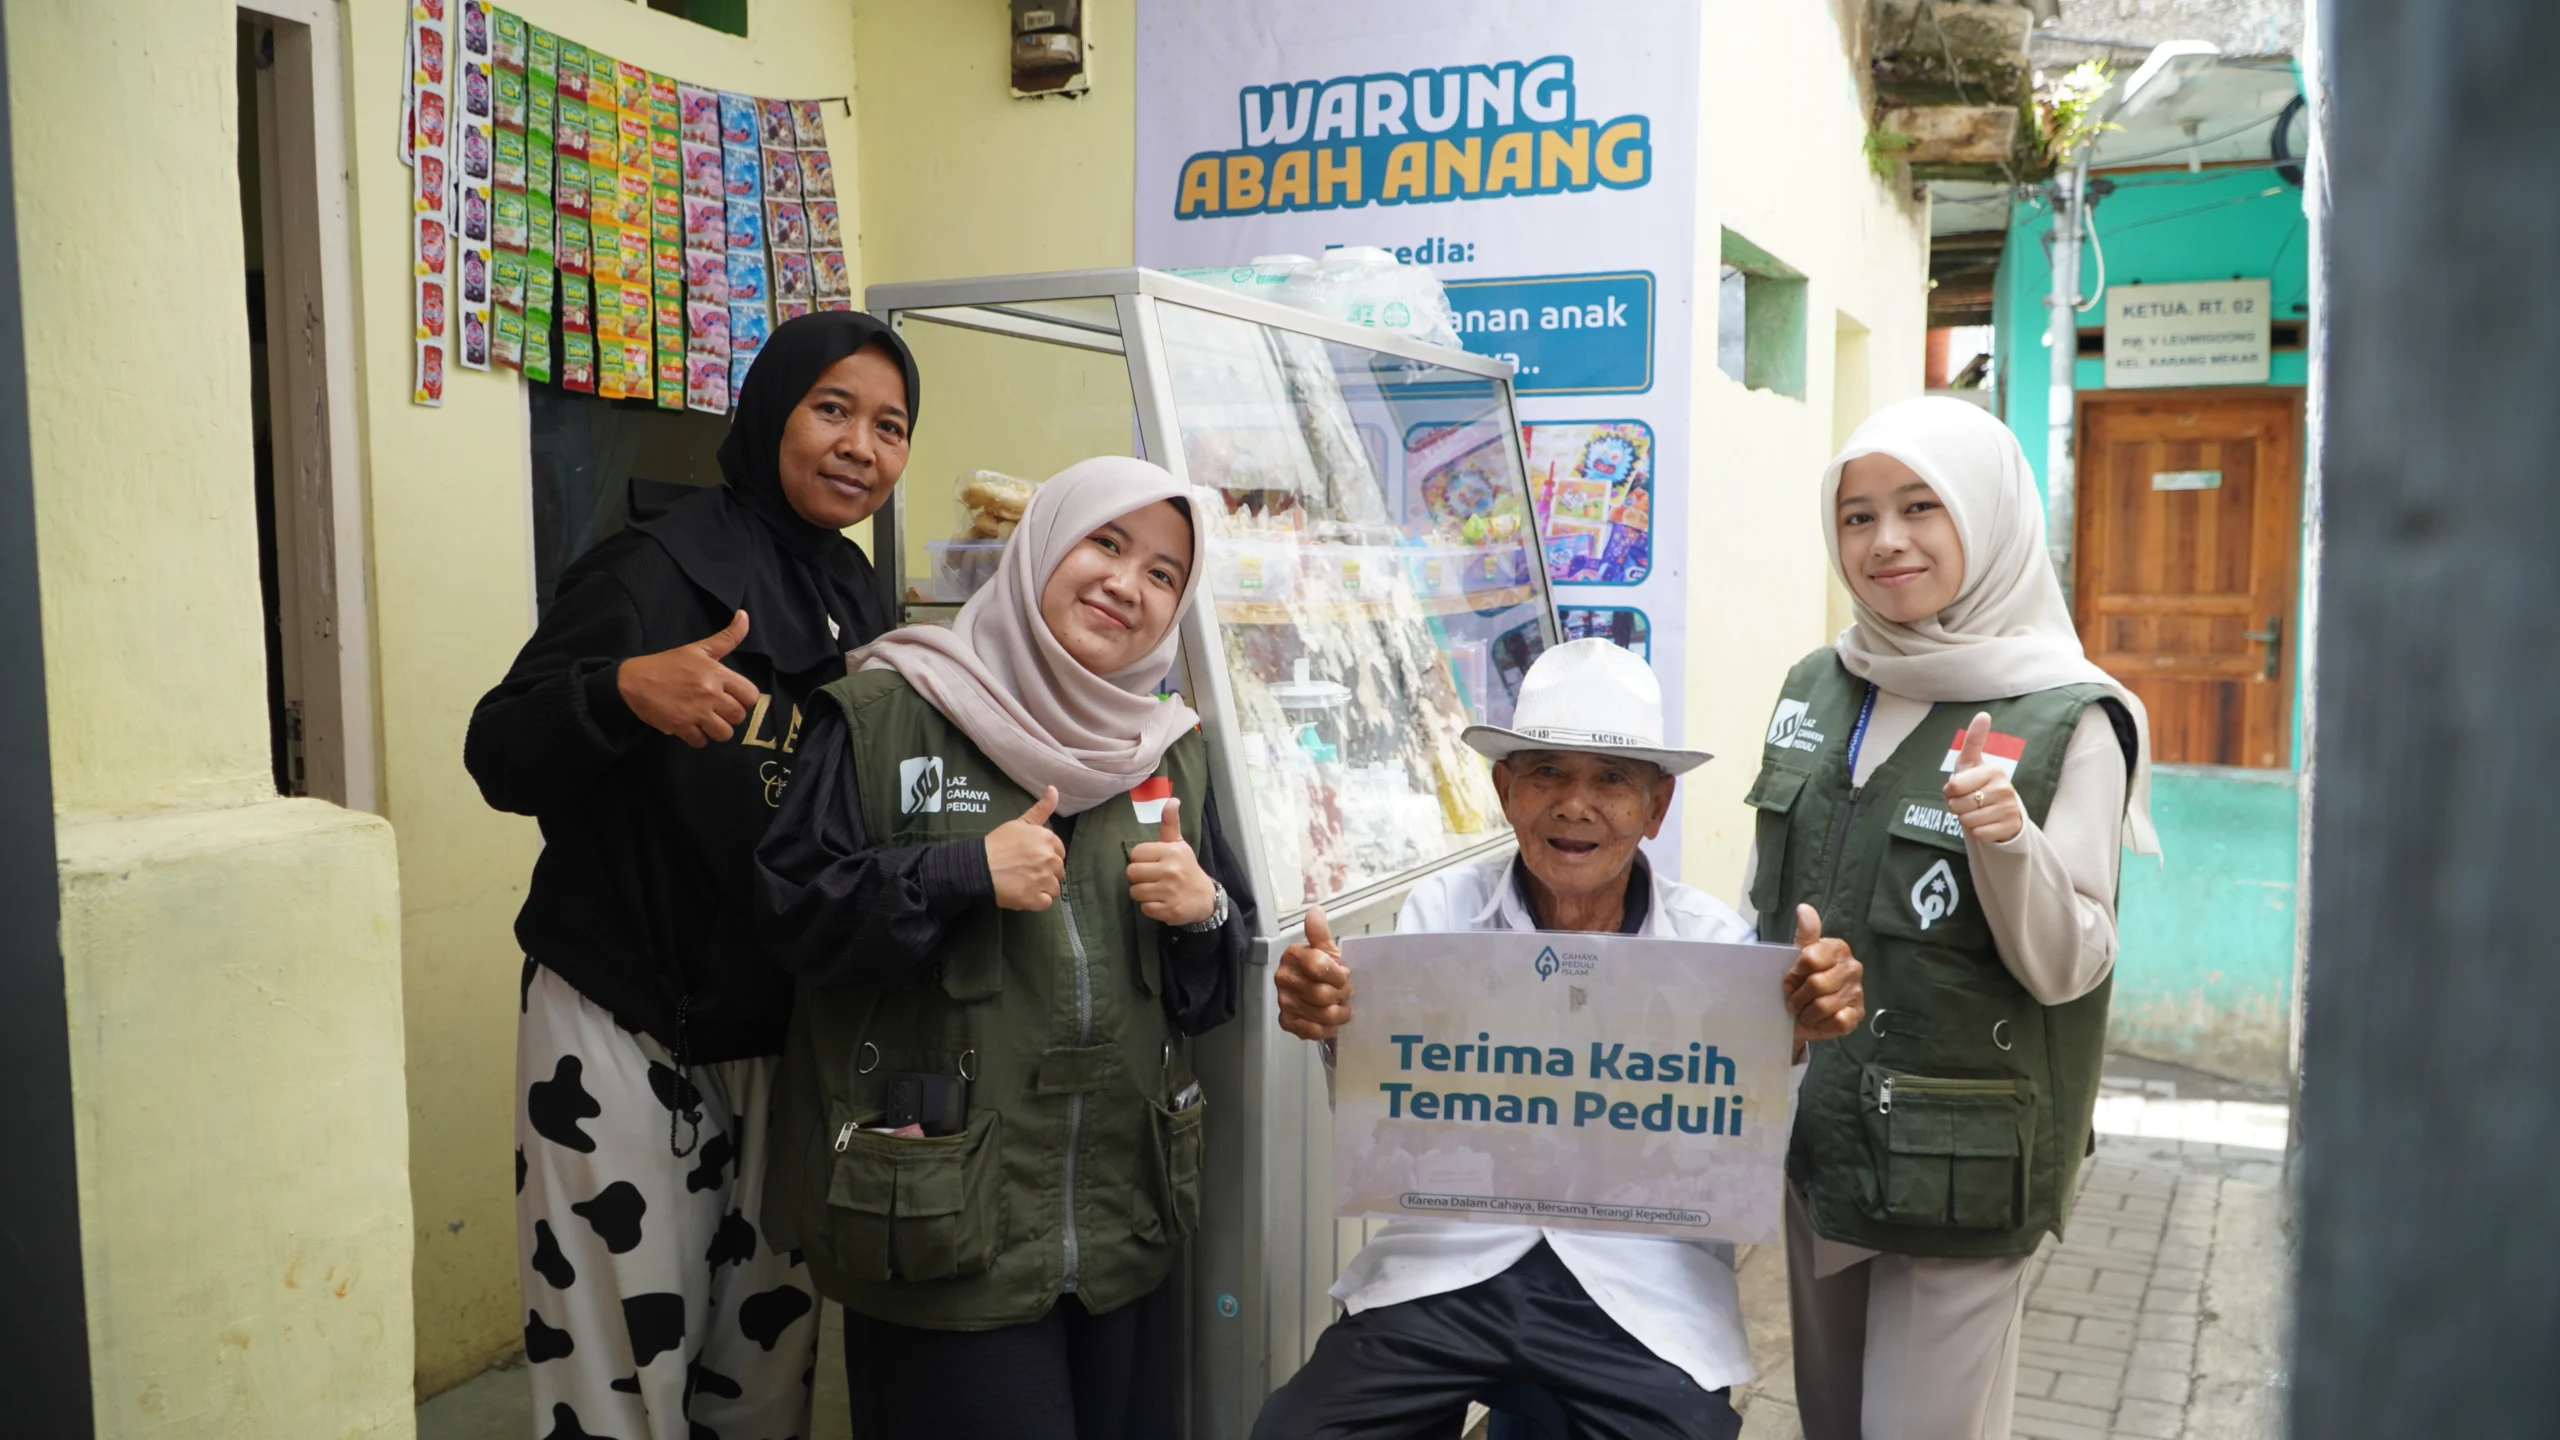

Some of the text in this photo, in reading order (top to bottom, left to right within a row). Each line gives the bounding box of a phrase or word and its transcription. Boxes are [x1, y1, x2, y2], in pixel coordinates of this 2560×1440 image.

[1243, 62, 1569, 148] WARUNG
[1179, 122, 1645, 213] ABAH ANANG
[1452, 296, 1629, 332] anan anak
[946, 776, 968, 787] LAZ
[946, 789, 991, 801] CAHAYA
[946, 802, 986, 813] PEDULI
[1903, 804, 1944, 832] CAHAYA
[1562, 953, 1598, 961] CAHAYA
[1562, 961, 1595, 969] PEDULI
[1390, 1032, 1737, 1086] Terima Kasih
[1379, 1082, 1744, 1137] Teman Peduli
[1408, 1195, 1702, 1223] Karena Dalam Cahaya, Bersama Terangi Kepedulian
